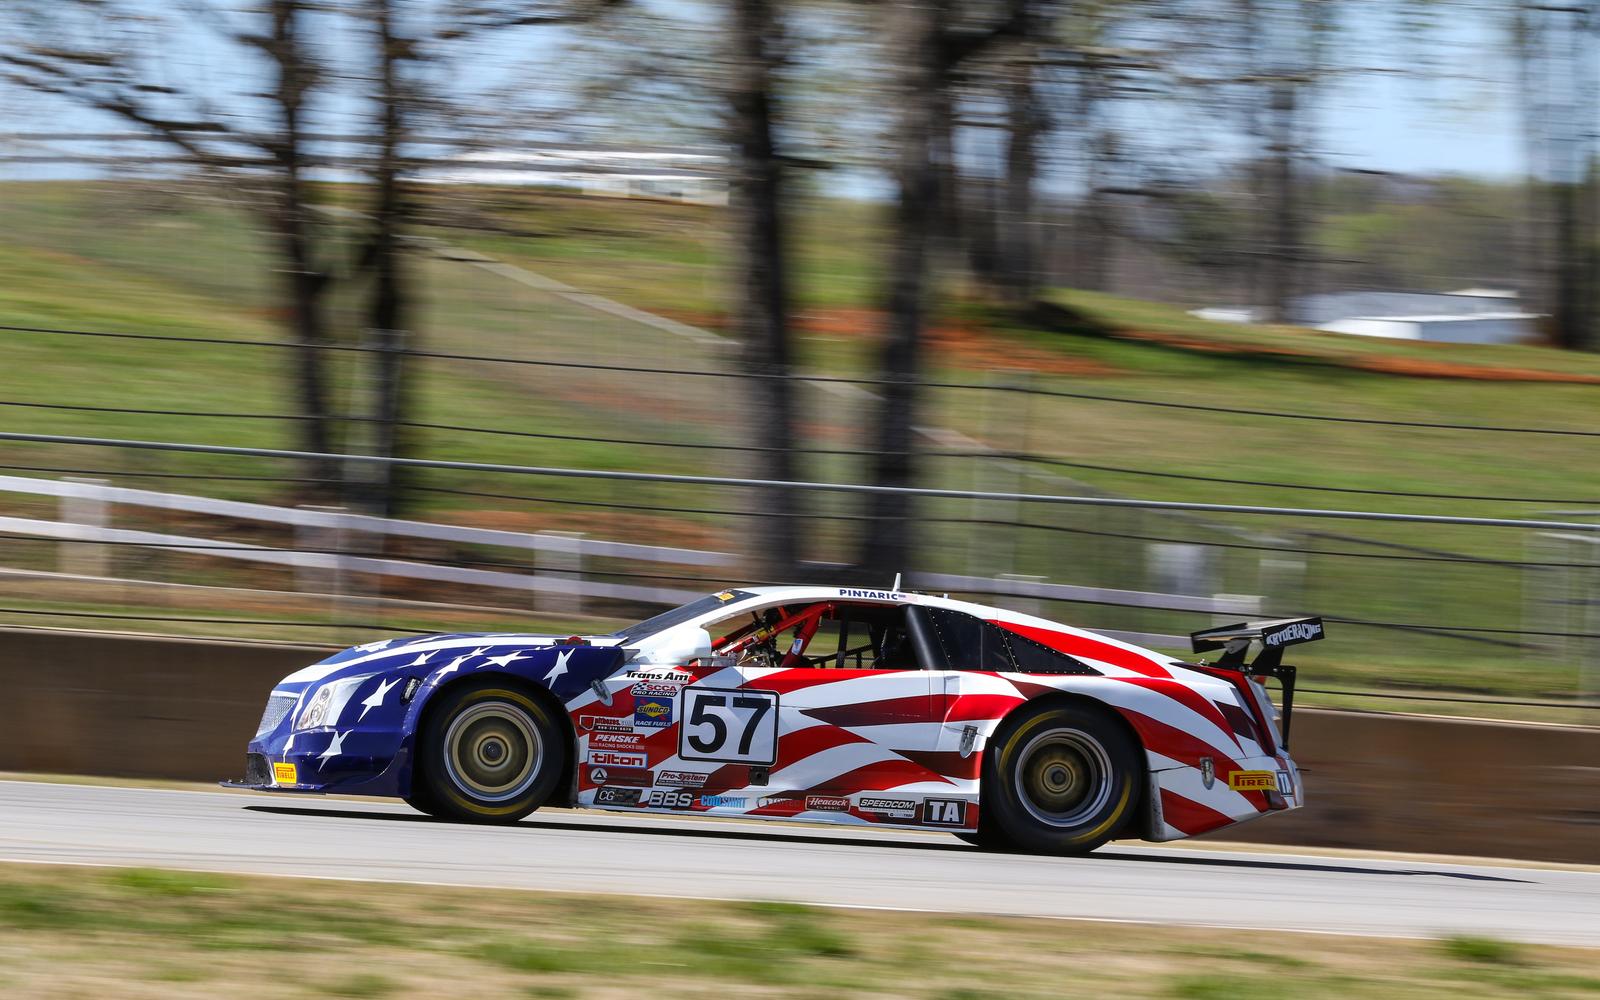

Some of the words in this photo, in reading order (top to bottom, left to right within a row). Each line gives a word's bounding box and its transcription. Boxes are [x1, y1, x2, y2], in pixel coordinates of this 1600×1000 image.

[839, 589, 898, 600] PINTARIC
[626, 670, 662, 680] Trans
[664, 672, 689, 681] Am
[646, 684, 677, 692] SCCA
[687, 694, 772, 756] 57
[595, 734, 641, 744] PENSKE
[591, 752, 643, 766] tilton
[275, 767, 296, 779] PIRELLI
[661, 772, 706, 782] Pro-System
[599, 790, 615, 801] CG
[649, 791, 693, 807] BBS
[808, 797, 848, 807] Heacock
[860, 799, 914, 809] SPEEDCOM
[929, 801, 960, 822] TA
